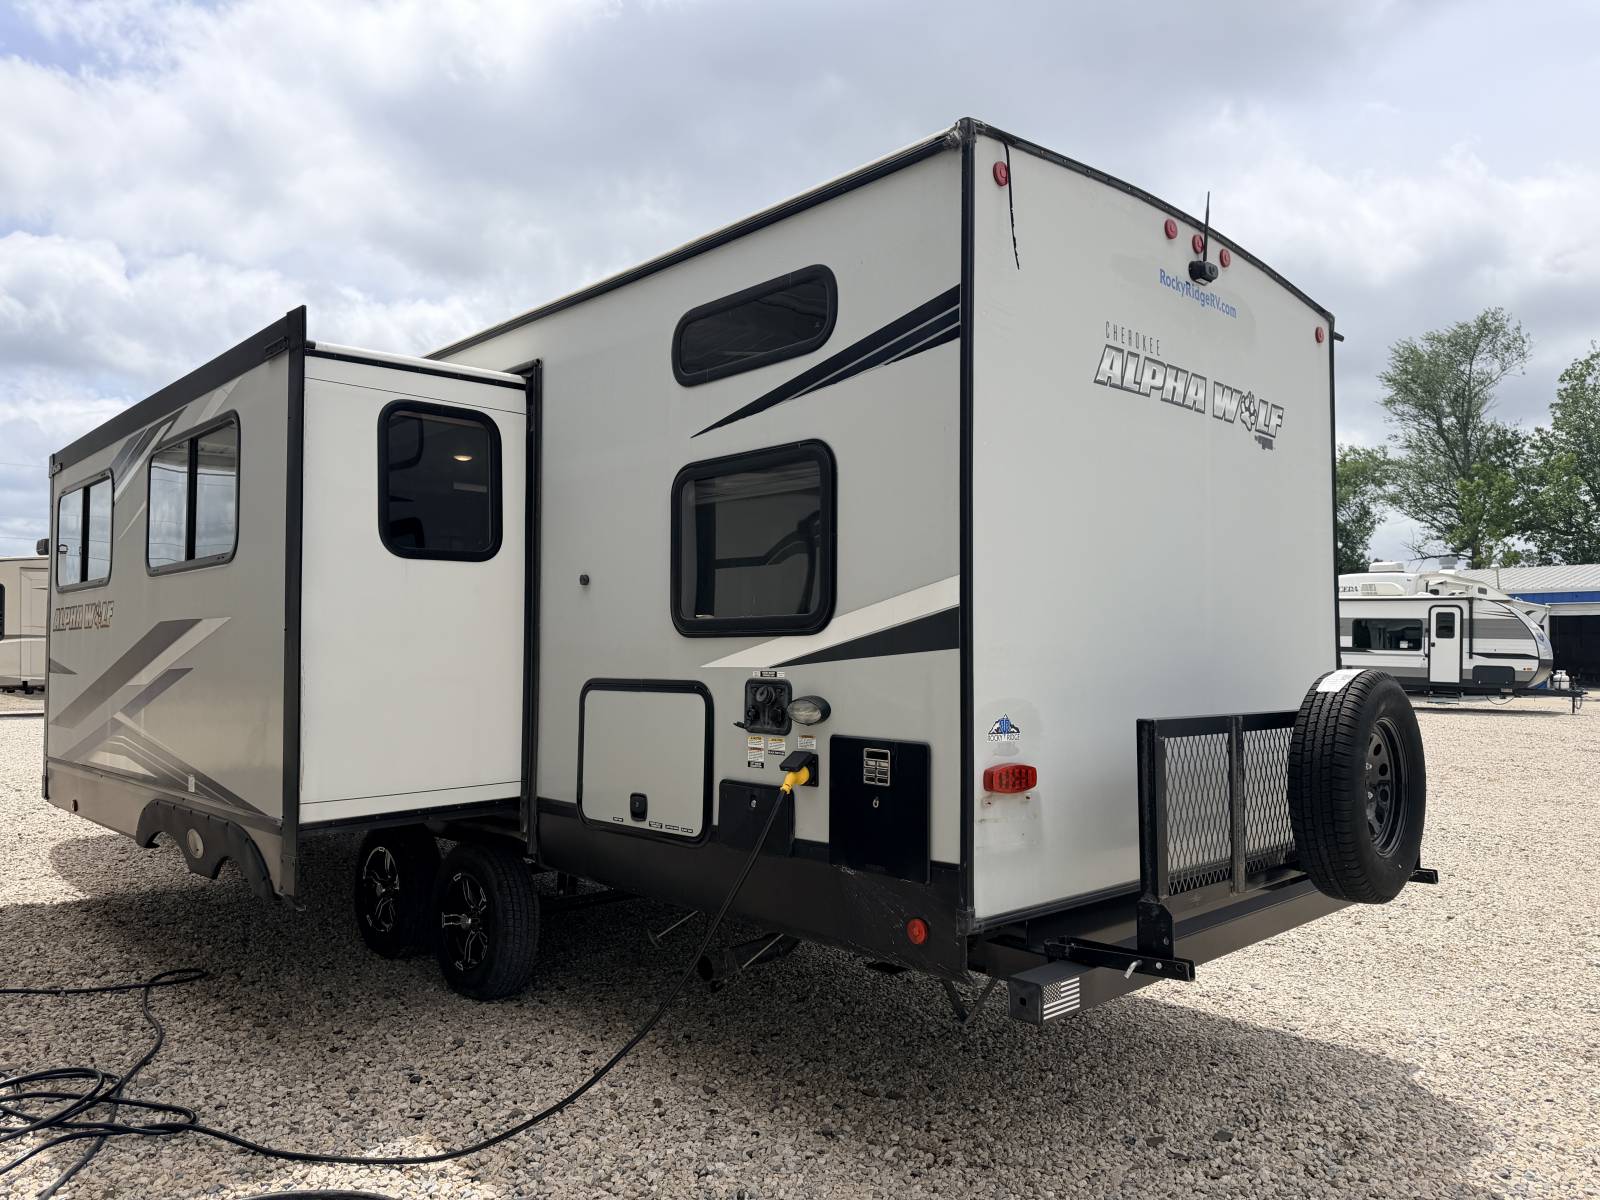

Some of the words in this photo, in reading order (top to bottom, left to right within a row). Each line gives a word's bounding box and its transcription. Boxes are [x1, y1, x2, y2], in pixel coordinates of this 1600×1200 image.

[1159, 268, 1237, 319] RockyRidgeRV.com
[1105, 320, 1161, 356] CHEROKEE
[1093, 343, 1207, 414] ALPHA
[1212, 381, 1285, 438] WOLF
[53, 604, 83, 632] ALPHA
[84, 600, 114, 630] WOLF
